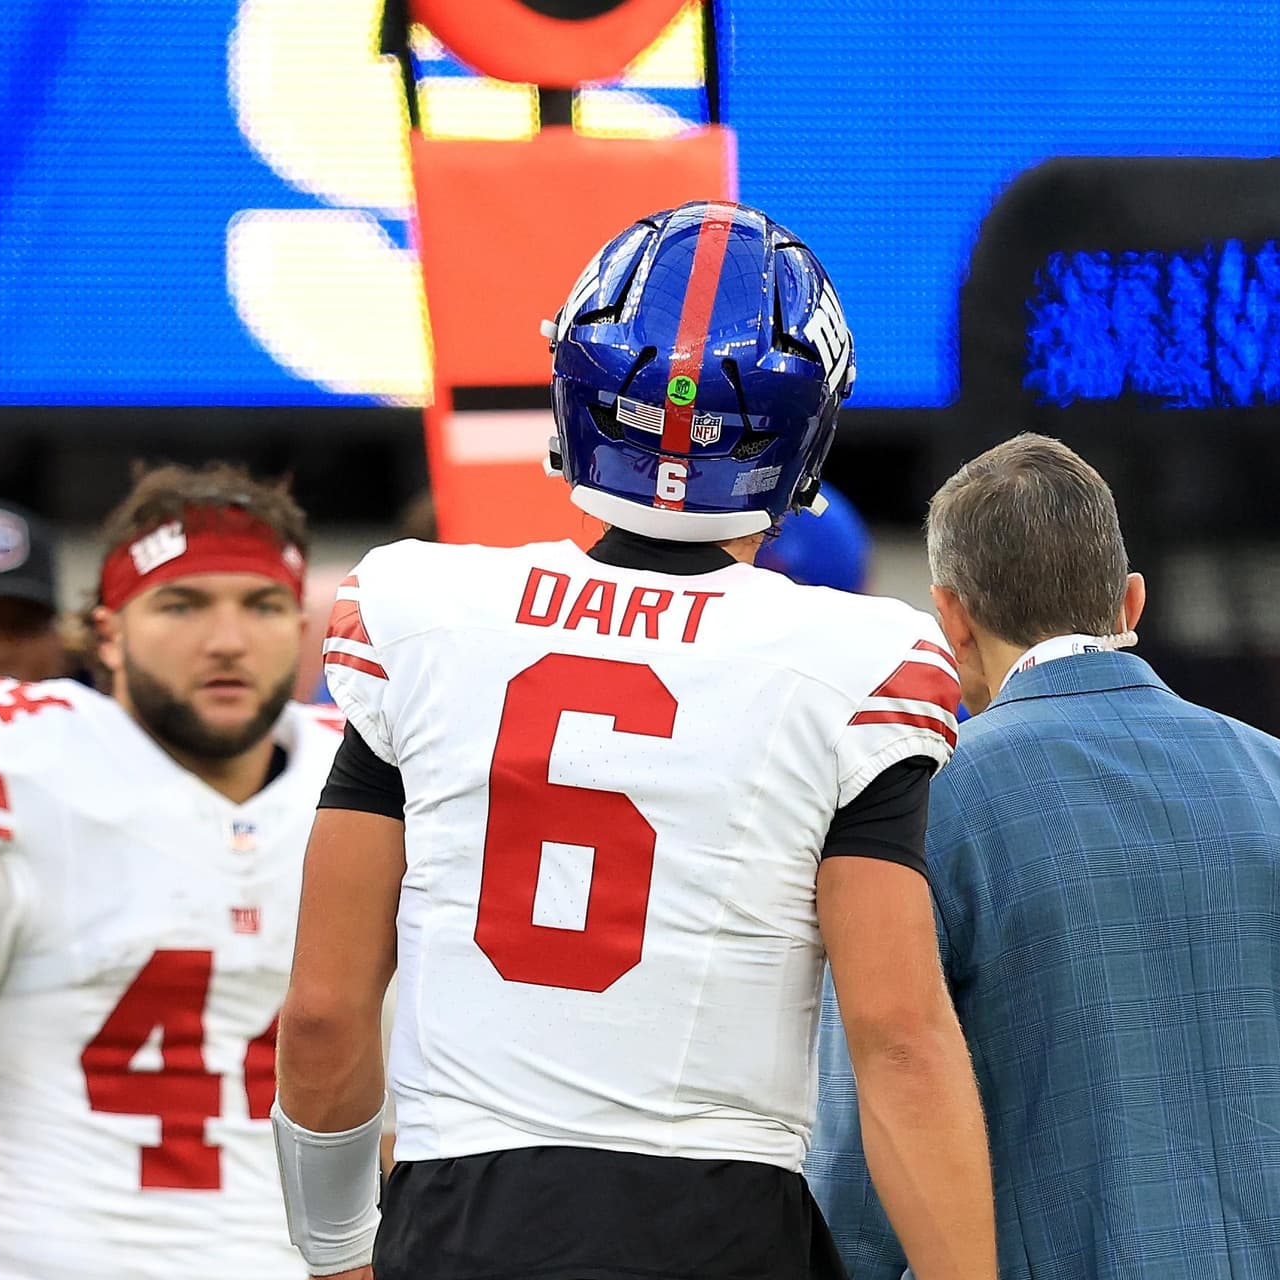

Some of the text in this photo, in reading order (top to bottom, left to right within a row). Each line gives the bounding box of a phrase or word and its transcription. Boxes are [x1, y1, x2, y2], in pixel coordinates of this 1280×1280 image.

[696, 426, 716, 440] NFL
[656, 462, 687, 501] 6
[516, 567, 725, 643] DART
[474, 652, 678, 992] 6
